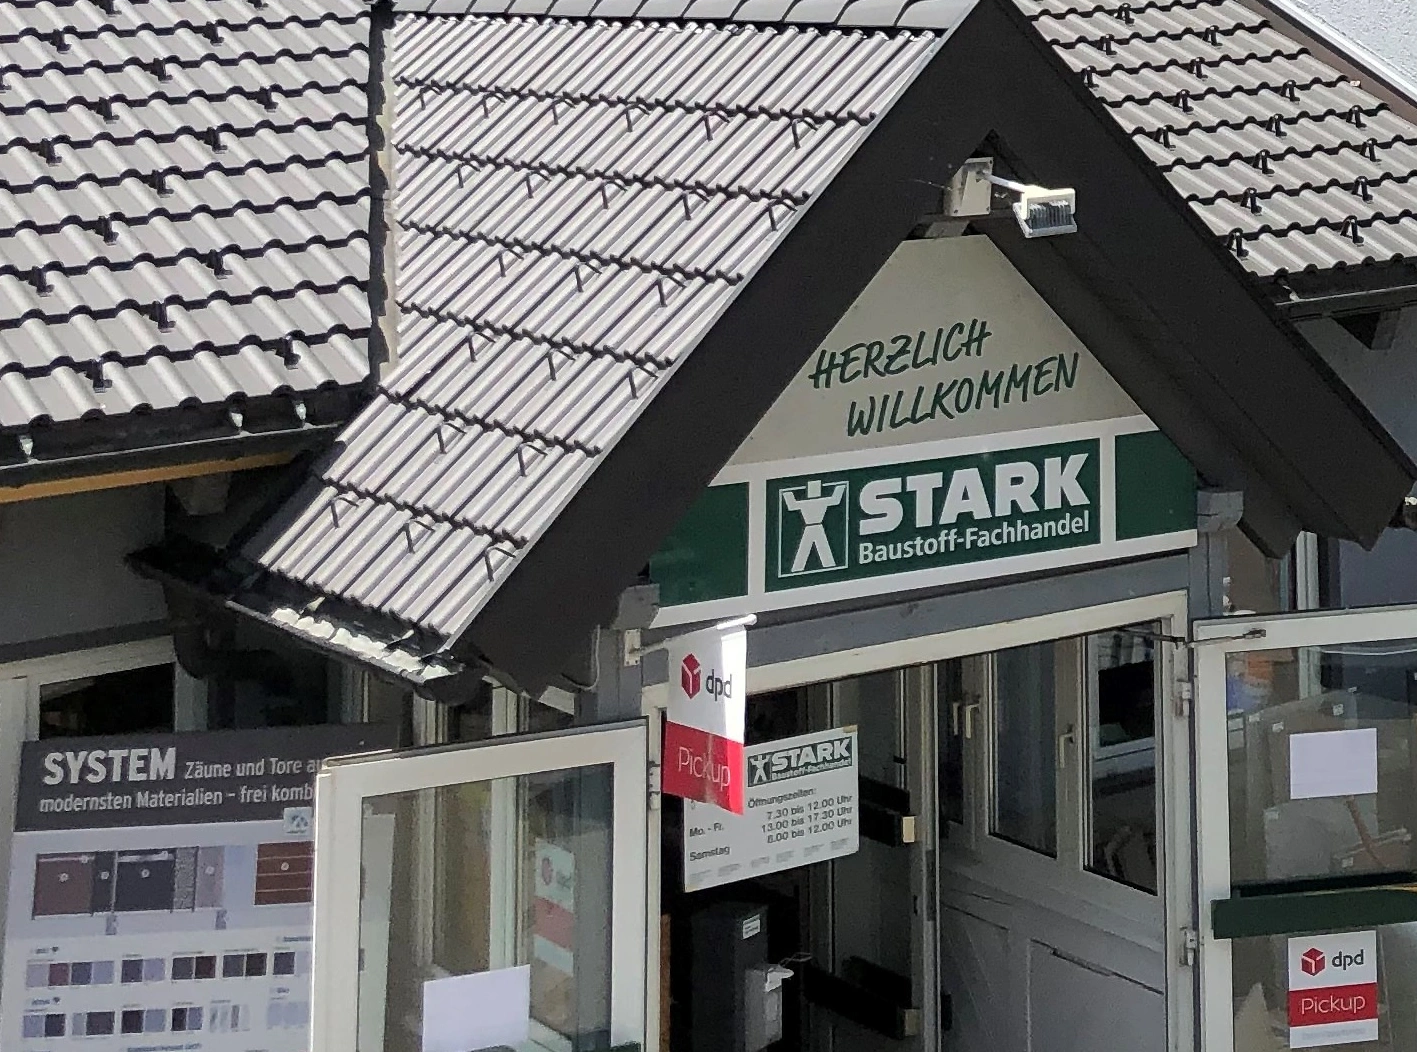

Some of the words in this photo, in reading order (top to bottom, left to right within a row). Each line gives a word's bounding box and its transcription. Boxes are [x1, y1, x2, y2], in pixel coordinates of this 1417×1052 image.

[807, 318, 993, 390] HERZLICH
[846, 352, 1080, 438] WILLKOMMEN
[859, 453, 1090, 536] STARK
[858, 510, 1090, 565] Baustoff-Fachhandel
[706, 669, 732, 702] dpd
[43, 747, 177, 786] SYSTEM
[185, 760, 231, 780] Zäune
[236, 759, 264, 777] und
[269, 757, 302, 776] Tore
[678, 746, 731, 790] Pickup
[771, 739, 851, 772] STARK
[39, 793, 132, 813] modernsten
[137, 788, 223, 809] Materialien
[239, 785, 267, 804] frei
[791, 805, 804, 815] bis
[808, 798, 834, 811] 12.00
[837, 795, 852, 805] Uhr
[791, 818, 804, 827] bis
[808, 809, 834, 823] 17.30
[837, 807, 852, 816] Uhr
[689, 846, 730, 861] Samstag
[791, 829, 804, 838] bis
[808, 821, 834, 834] 12.00
[837, 818, 852, 828] Uhr
[1331, 949, 1364, 970] dpd
[1301, 995, 1366, 1015] Pickup
